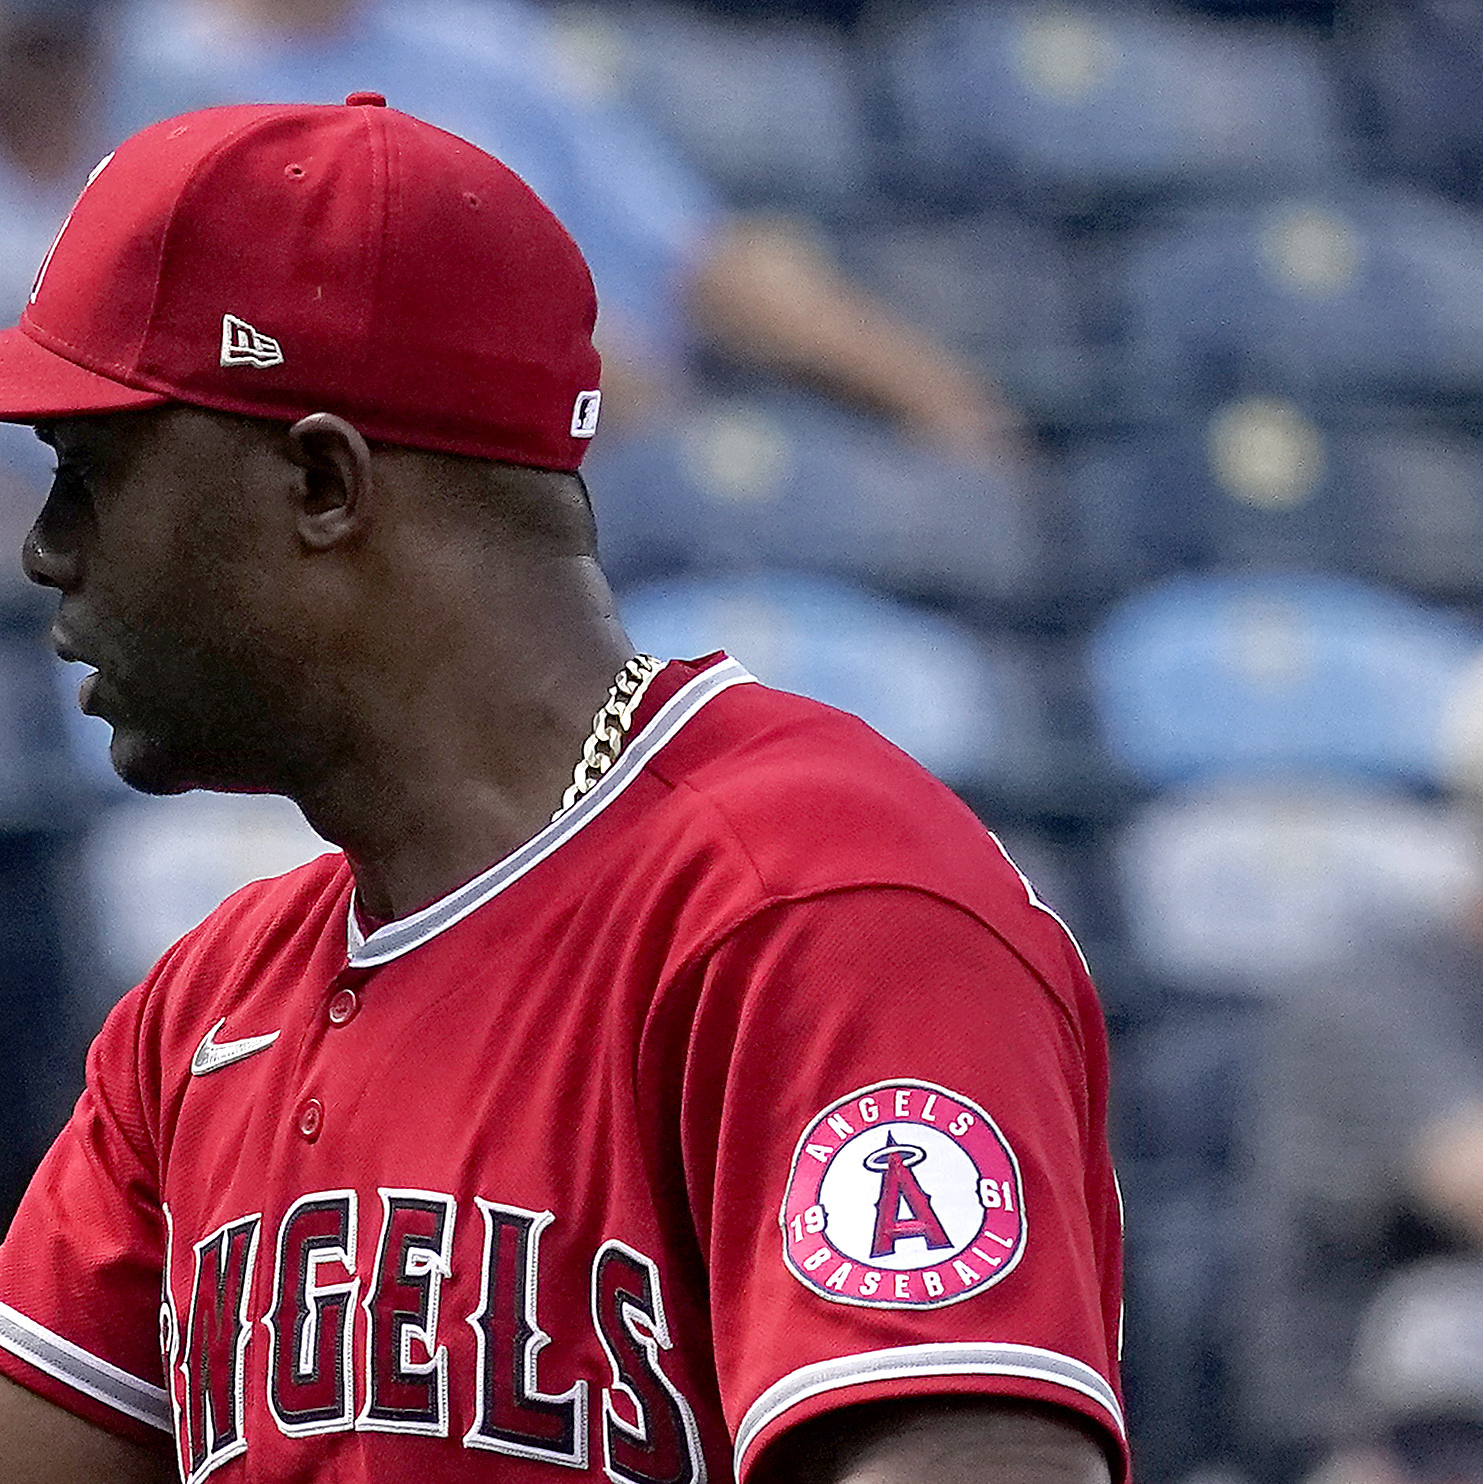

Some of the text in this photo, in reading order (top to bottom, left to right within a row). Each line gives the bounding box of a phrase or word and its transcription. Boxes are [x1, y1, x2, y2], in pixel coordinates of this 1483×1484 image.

[804, 1089, 975, 1164] ANGELS
[979, 1178, 1015, 1212] 61
[789, 1204, 829, 1243] 19
[802, 1230, 1013, 1299] BASEBALL
